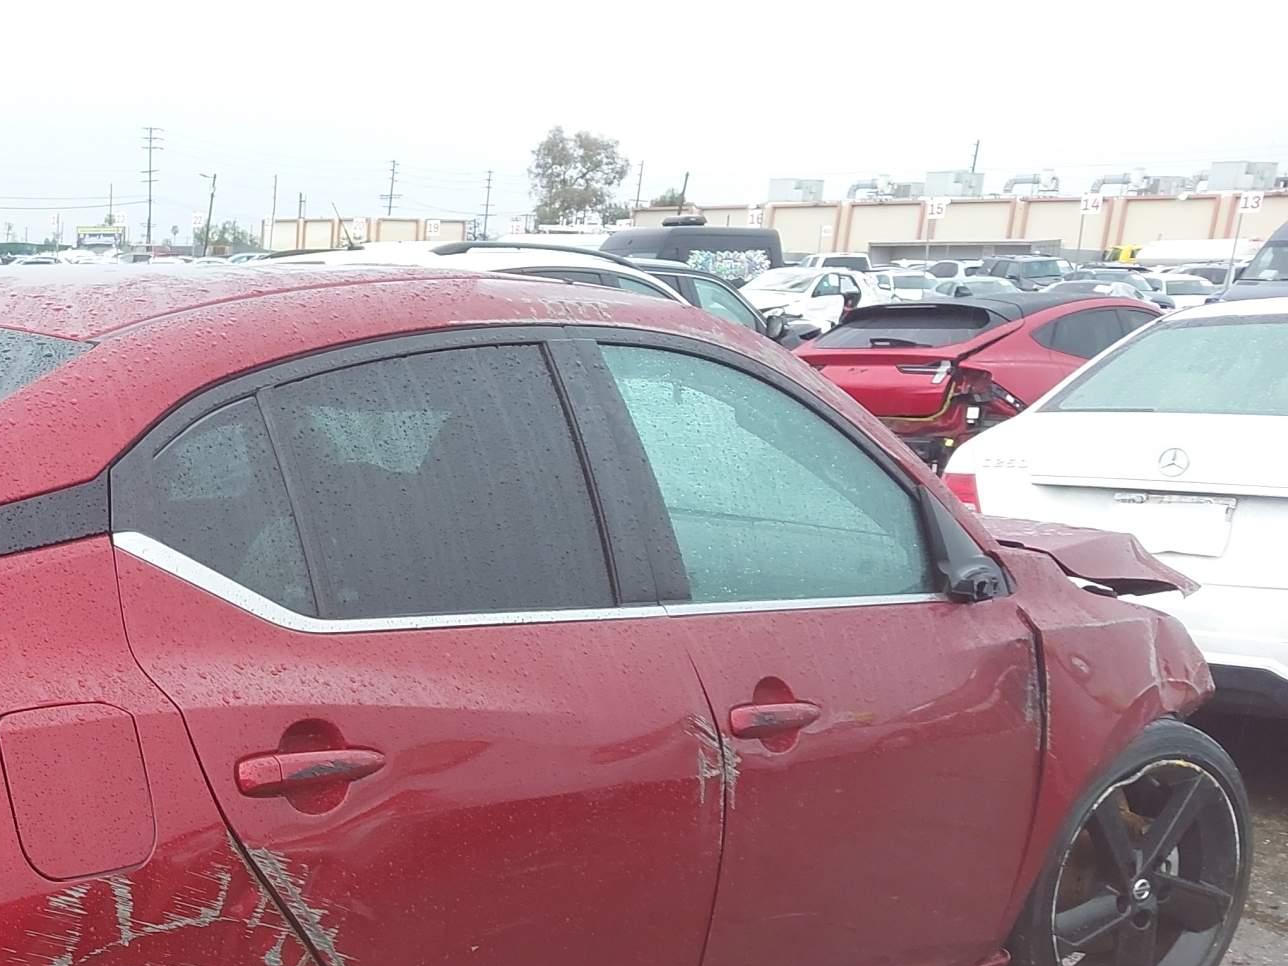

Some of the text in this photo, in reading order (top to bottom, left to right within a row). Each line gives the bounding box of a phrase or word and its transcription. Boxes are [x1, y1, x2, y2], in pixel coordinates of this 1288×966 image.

[1083, 198, 1100, 211] 14
[1240, 195, 1262, 209] 13
[928, 203, 944, 215] 15
[749, 212, 763, 225] 16
